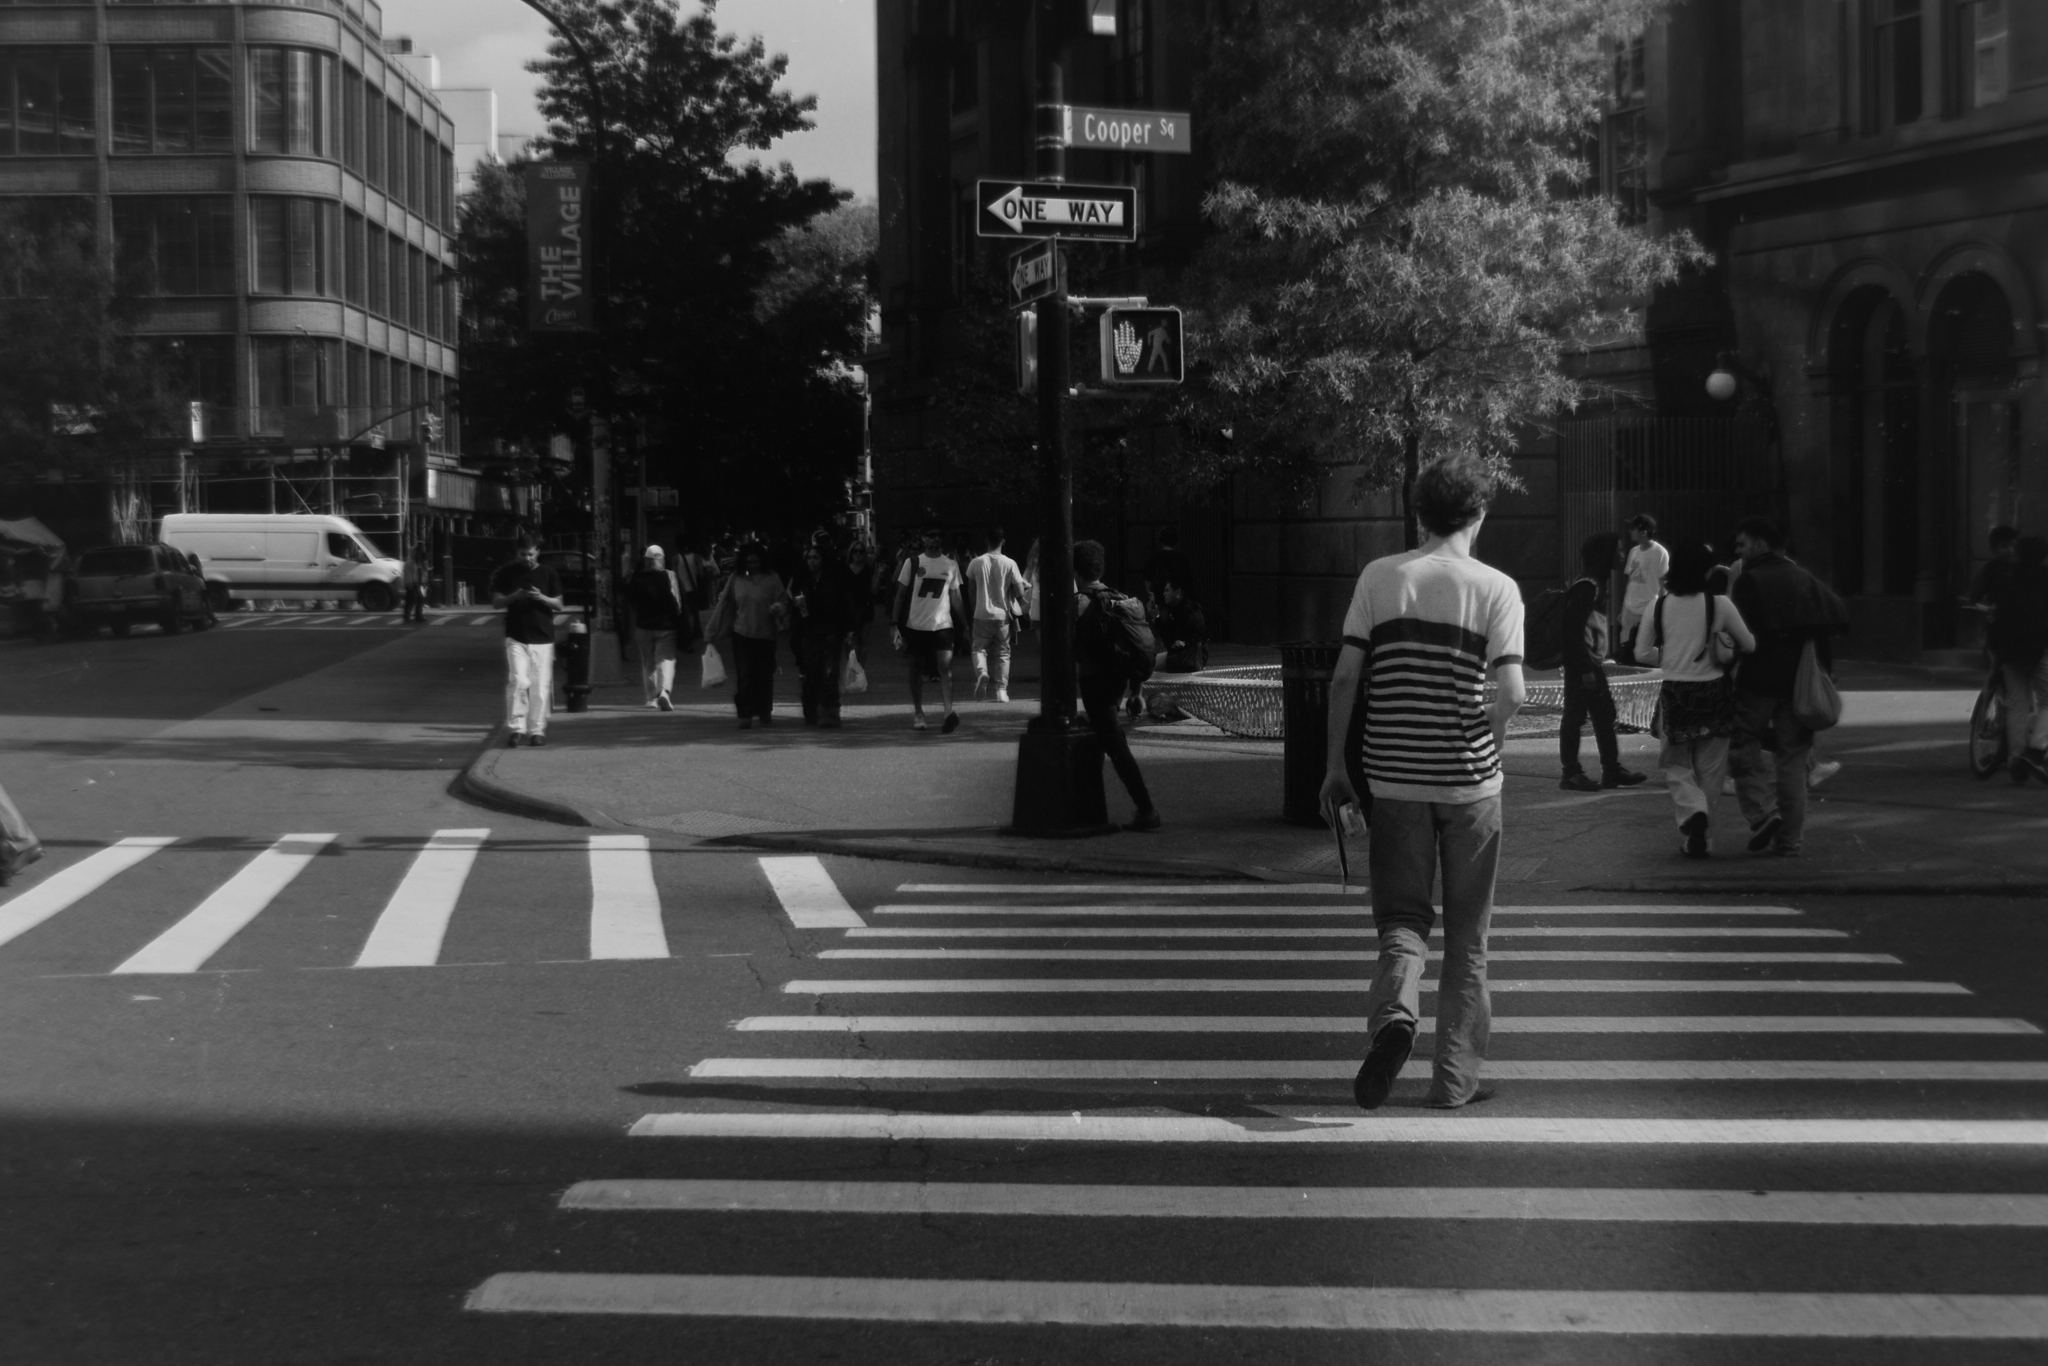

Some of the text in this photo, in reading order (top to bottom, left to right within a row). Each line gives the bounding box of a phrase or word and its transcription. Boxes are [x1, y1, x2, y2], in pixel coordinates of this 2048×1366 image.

[1084, 113, 1175, 149] Cooper Sq
[1002, 199, 1115, 223] ONE WAY
[560, 186, 583, 301] VILLAGE
[540, 246, 562, 301] THE
[1016, 257, 1049, 289] ONE WAY
